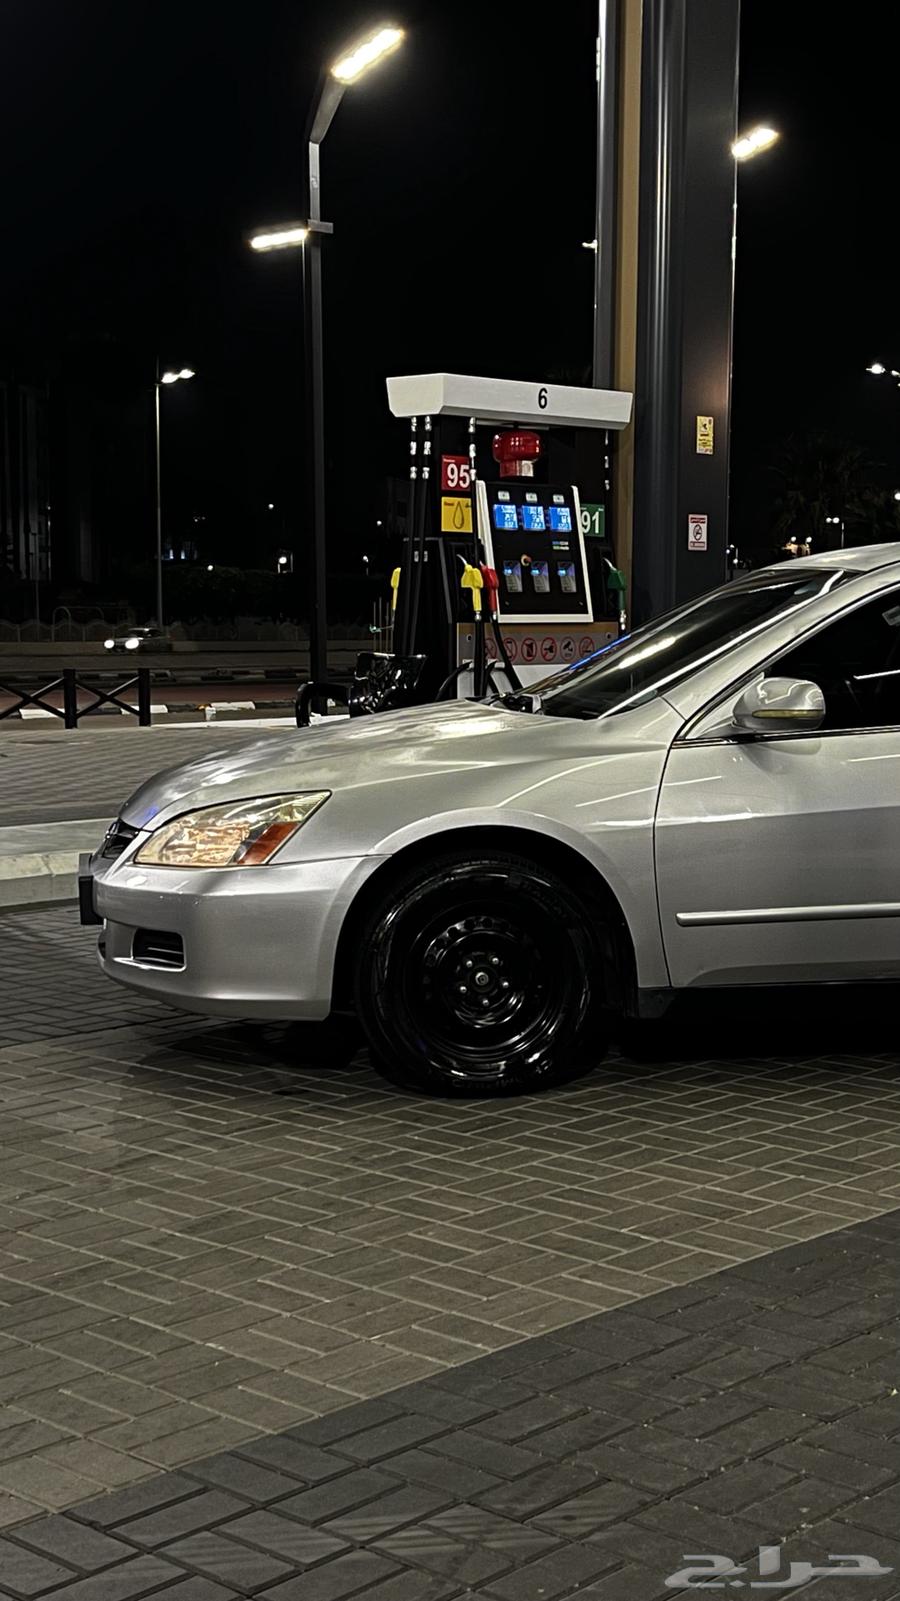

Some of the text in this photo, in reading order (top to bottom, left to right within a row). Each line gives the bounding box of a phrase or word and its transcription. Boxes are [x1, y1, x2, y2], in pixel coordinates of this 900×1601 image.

[538, 387, 548, 409] 6
[447, 463, 470, 488] 95
[581, 511, 600, 534] 91
